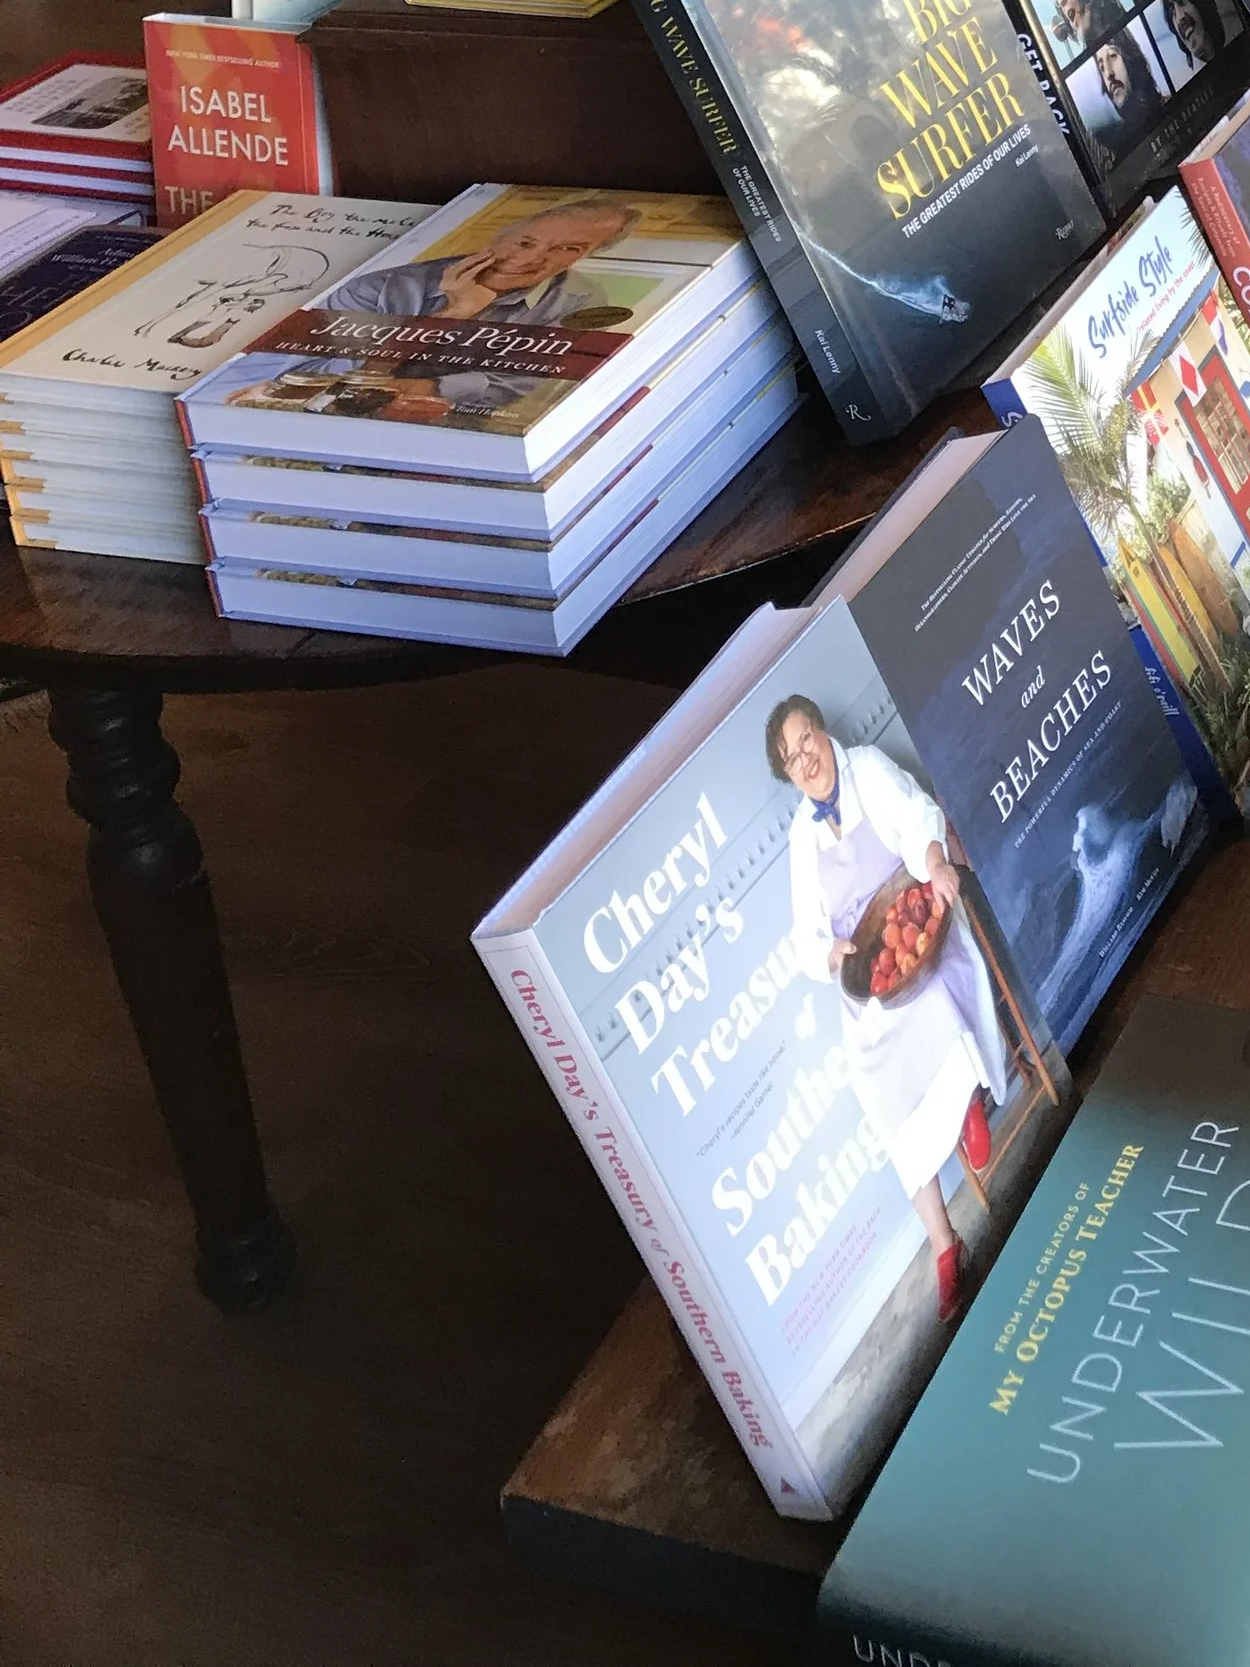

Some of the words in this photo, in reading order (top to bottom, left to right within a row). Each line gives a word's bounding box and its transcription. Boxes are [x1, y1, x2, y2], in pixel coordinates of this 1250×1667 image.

[180, 85, 272, 124] ISABEL
[661, 16, 699, 76] WAVE
[689, 77, 738, 156] SURFER
[880, 16, 998, 129] WAVE
[164, 185, 215, 216] THE
[167, 124, 289, 167] ALLENDE
[877, 72, 1026, 221] SURFER
[902, 219, 921, 239] THE
[919, 184, 961, 225] GREATEST
[959, 164, 985, 197] RIDES
[983, 154, 996, 172] OF
[993, 141, 1011, 162] OUR
[1008, 124, 1032, 152] LIVES
[247, 217, 269, 229] the
[304, 225, 336, 236] and
[338, 226, 362, 238] the
[270, 204, 298, 216] The
[344, 212, 370, 224] the
[62, 348, 126, 369] Charlie
[275, 341, 337, 355] HEART
[338, 346, 352, 356] &
[359, 348, 404, 360] SOUL
[408, 351, 433, 363] IN
[437, 354, 474, 366] THE
[479, 358, 567, 375] KITCHEN
[310, 315, 455, 347] Jacques
[461, 325, 574, 358] Pépin
[1088, 280, 1140, 359] Surfside
[1138, 235, 1174, 297] Style
[961, 578, 1062, 708] WAVES
[1020, 665, 1047, 709] and
[989, 649, 1113, 824] BEACHES
[583, 791, 728, 974] Cheryl
[614, 895, 745, 1056] Day's
[509, 968, 565, 1052] Cheryl
[553, 1053, 602, 1122] Day's
[595, 1126, 659, 1233] Treasury
[651, 1237, 669, 1258] of
[664, 1259, 728, 1365] Southern
[721, 1370, 774, 1449] Baking
[744, 1116, 891, 1308] Baking
[993, 1309, 1024, 1355] FROM
[1018, 1277, 1041, 1307] THE
[1035, 1202, 1080, 1276] CREATORS
[1075, 1181, 1091, 1201] OF
[988, 1369, 1024, 1417] MY
[1015, 1247, 1089, 1365] OCTOPUS
[1075, 1143, 1146, 1243] TEACHER
[1026, 1120, 1241, 1484] UNDERWATER
